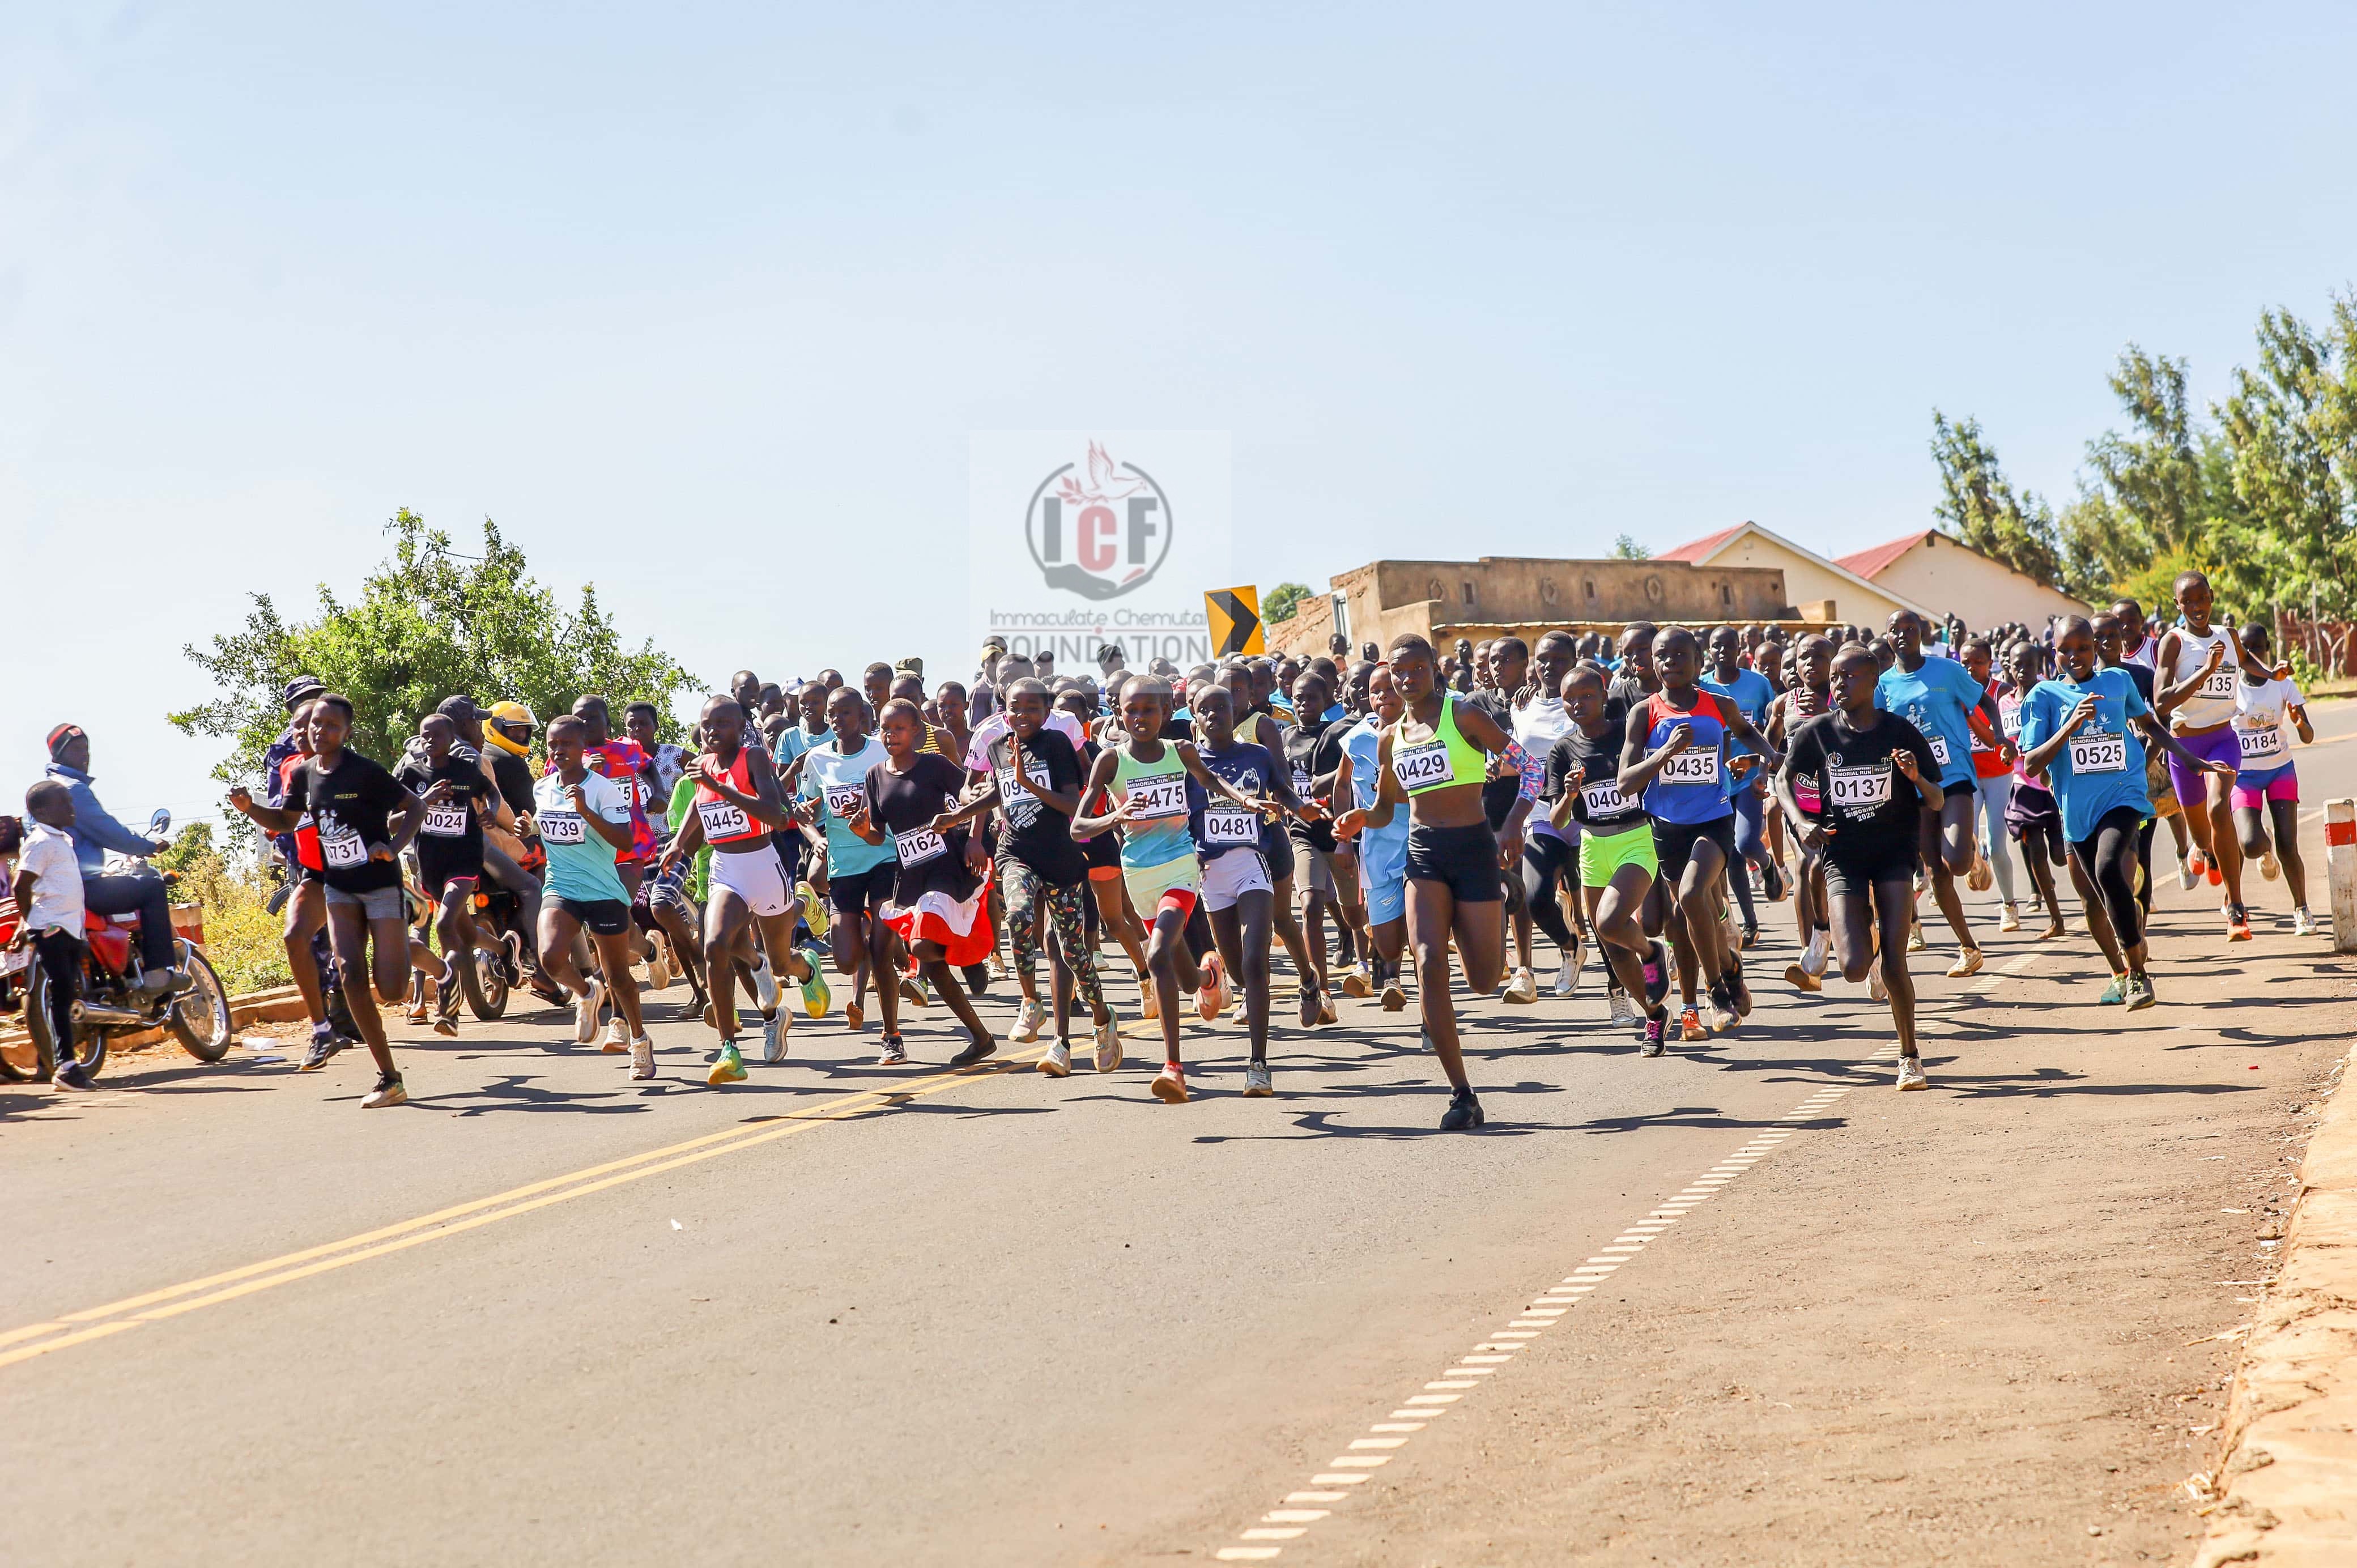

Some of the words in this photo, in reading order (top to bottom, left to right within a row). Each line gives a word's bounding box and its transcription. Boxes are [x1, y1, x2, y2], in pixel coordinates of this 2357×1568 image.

[2242, 732, 2277, 750] 0184
[2075, 744, 2122, 765] 0525
[1397, 754, 1445, 781] 0429
[1664, 757, 1714, 776] 0435
[1834, 777, 1887, 798] 0137
[425, 812, 462, 828] 0024
[703, 808, 744, 830] 0445
[1022, 816, 1037, 828] 2025
[1857, 811, 1875, 822] 2025
[541, 821, 579, 836] 0739
[1209, 817, 1253, 836] 0481
[325, 840, 358, 860] 0737
[900, 832, 940, 858] 0162
